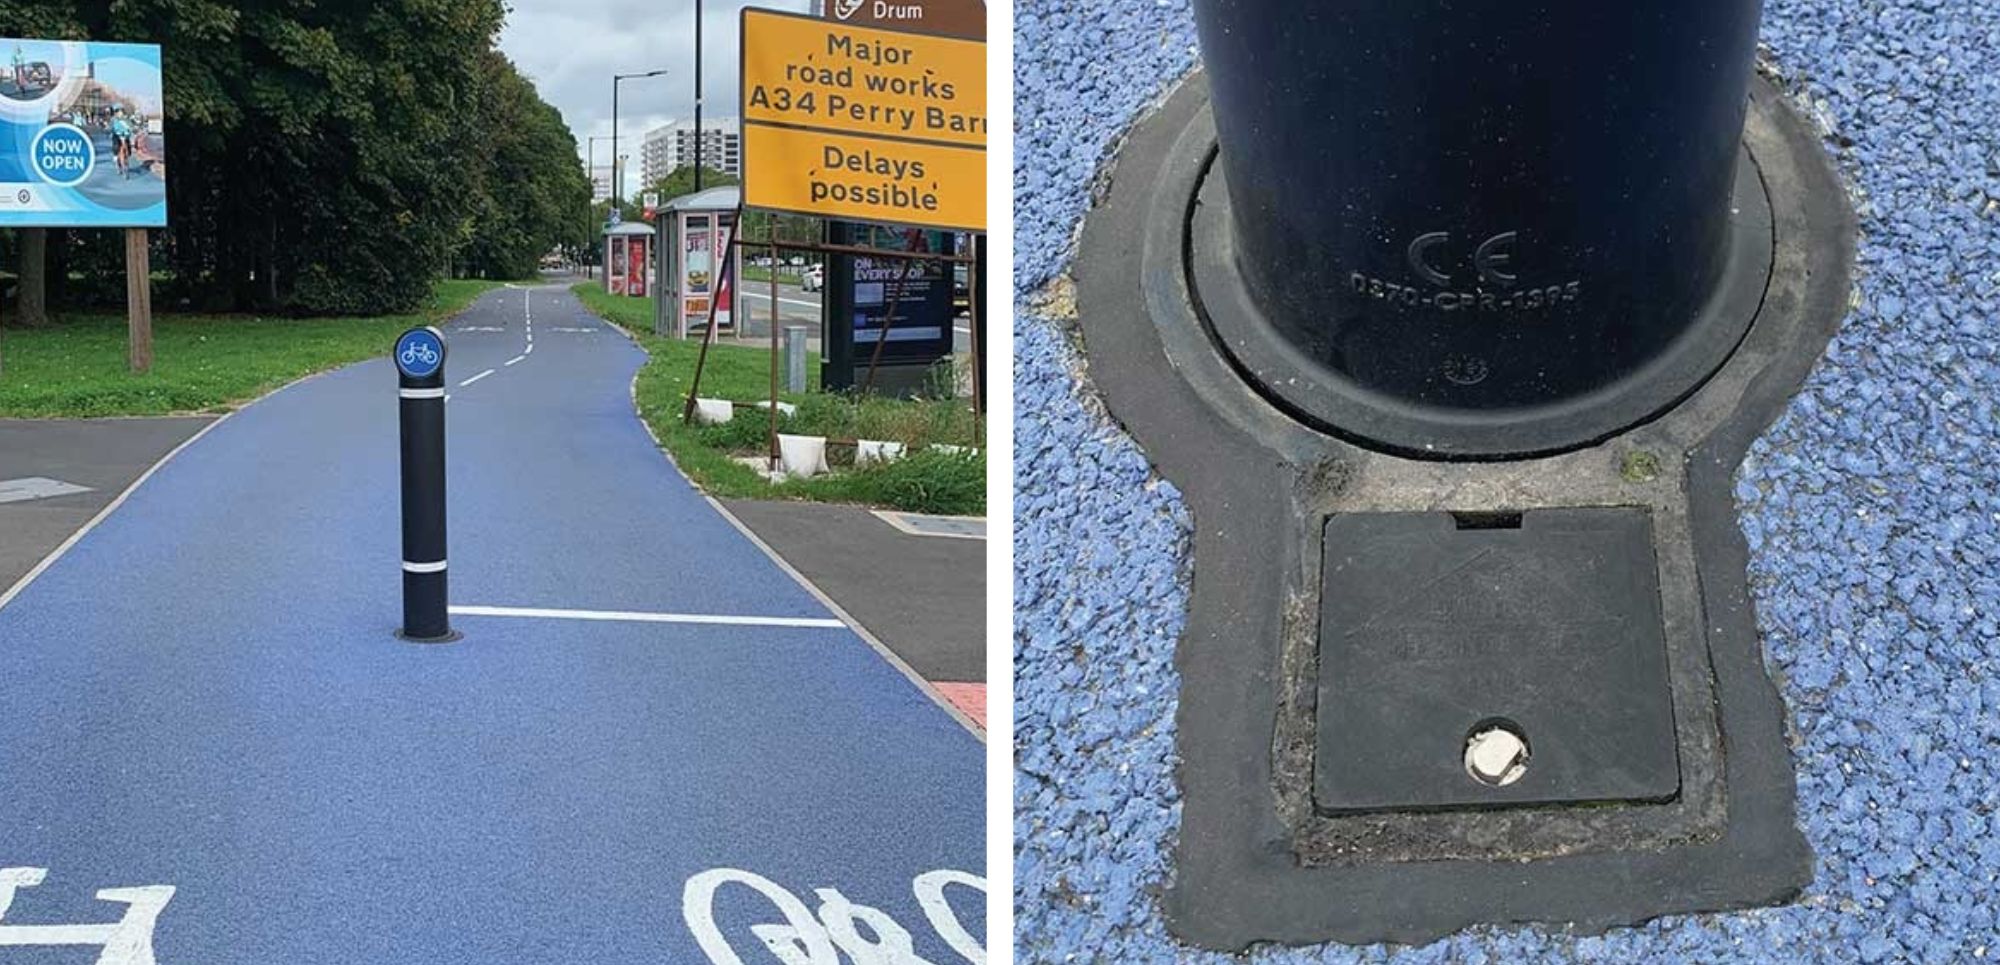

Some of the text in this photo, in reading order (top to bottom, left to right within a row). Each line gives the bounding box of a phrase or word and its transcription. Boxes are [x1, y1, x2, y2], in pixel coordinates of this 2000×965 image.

[874, 1, 922, 19] Drum
[828, 33, 912, 66] Major
[787, 63, 955, 100] road works
[750, 85, 816, 114] A34
[828, 94, 915, 130] Perry
[43, 138, 82, 154] NOW
[42, 155, 84, 170] OPEN
[824, 146, 925, 180] Delays
[811, 181, 938, 211] possible
[854, 268, 925, 280] EVERY SOP
